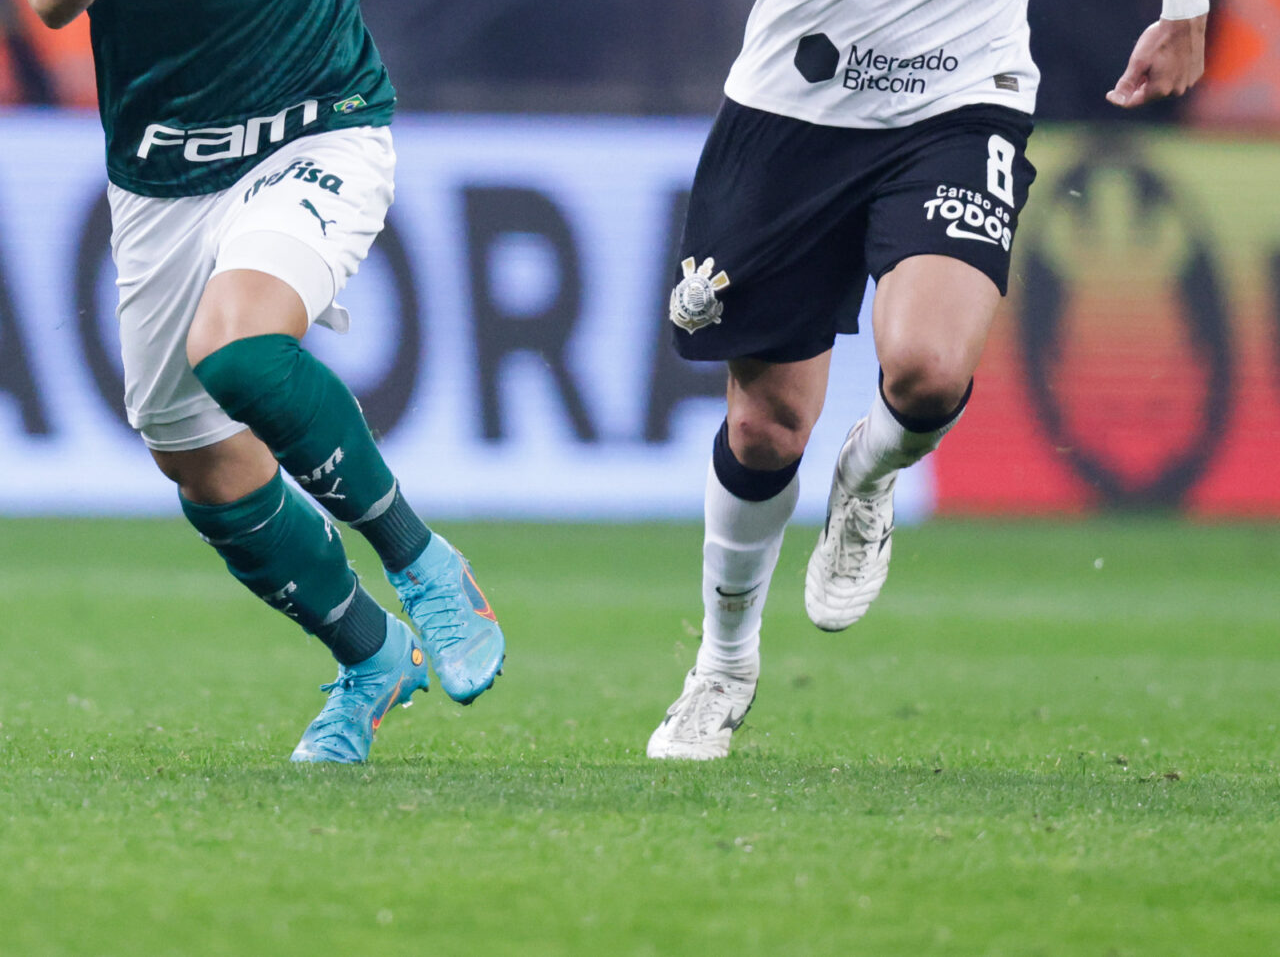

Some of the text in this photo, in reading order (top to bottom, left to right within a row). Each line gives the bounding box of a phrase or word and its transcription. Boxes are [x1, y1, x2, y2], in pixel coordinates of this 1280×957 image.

[847, 45, 959, 72] Mercado
[842, 68, 926, 94] Bitcoin
[987, 134, 1015, 209] 8
[936, 185, 1010, 224] Cartão de
[923, 198, 1012, 252] TODOS
